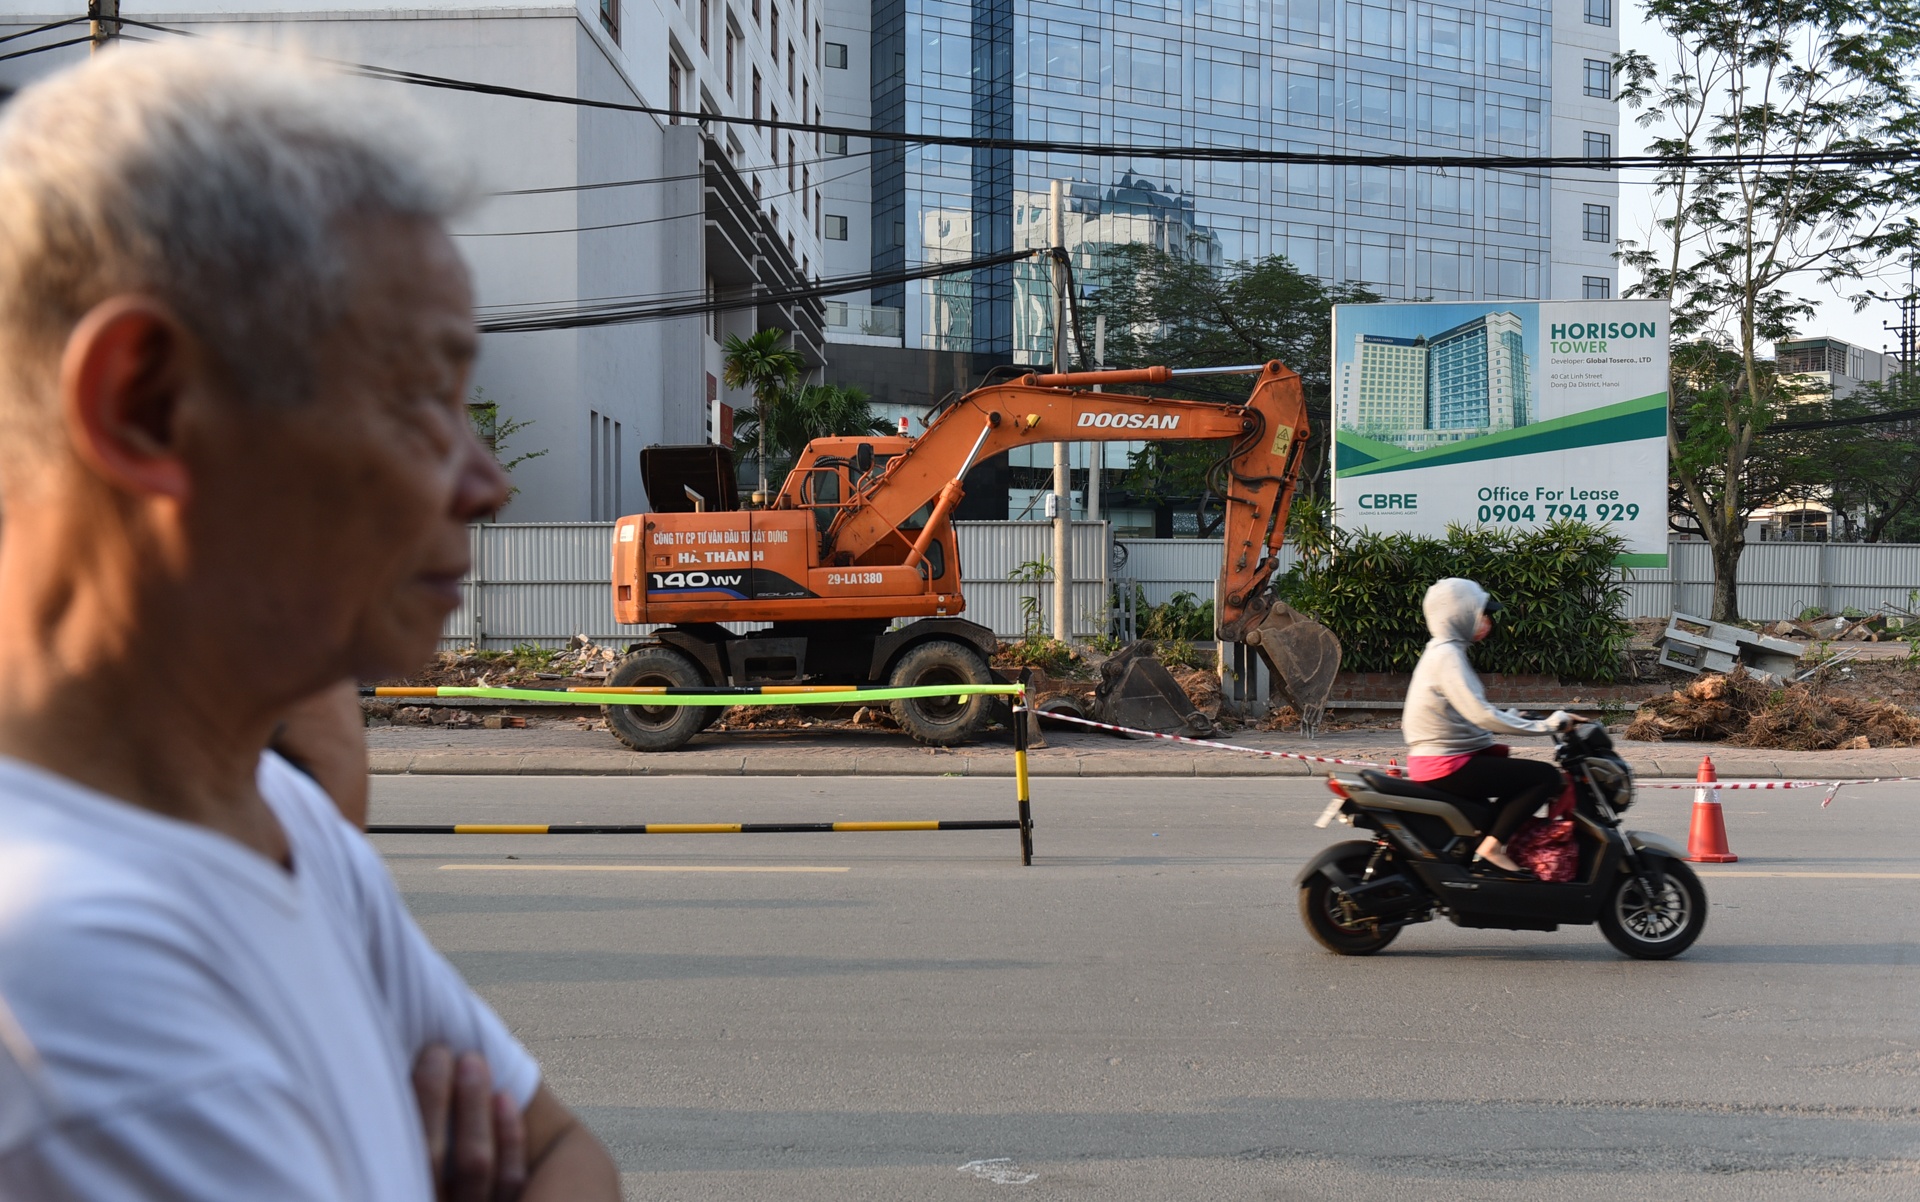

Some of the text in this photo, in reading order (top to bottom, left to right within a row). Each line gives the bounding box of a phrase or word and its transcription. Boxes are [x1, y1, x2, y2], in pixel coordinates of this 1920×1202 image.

[1551, 322, 1655, 339] HORISON
[1550, 341, 1607, 353] TOWER
[1077, 412, 1180, 430] DOOSAN
[1478, 487, 1619, 501] Office For Lease
[1358, 494, 1418, 509] CBRE
[1478, 503, 1640, 522] 0904 794 929
[653, 531, 674, 545] CÔNG
[675, 532, 684, 545] TY
[685, 532, 696, 545] CP
[698, 531, 708, 544] TƯ
[704, 549, 764, 563] THÀNH
[653, 572, 742, 588] 140 WV
[827, 573, 883, 585] 29-LA1380
